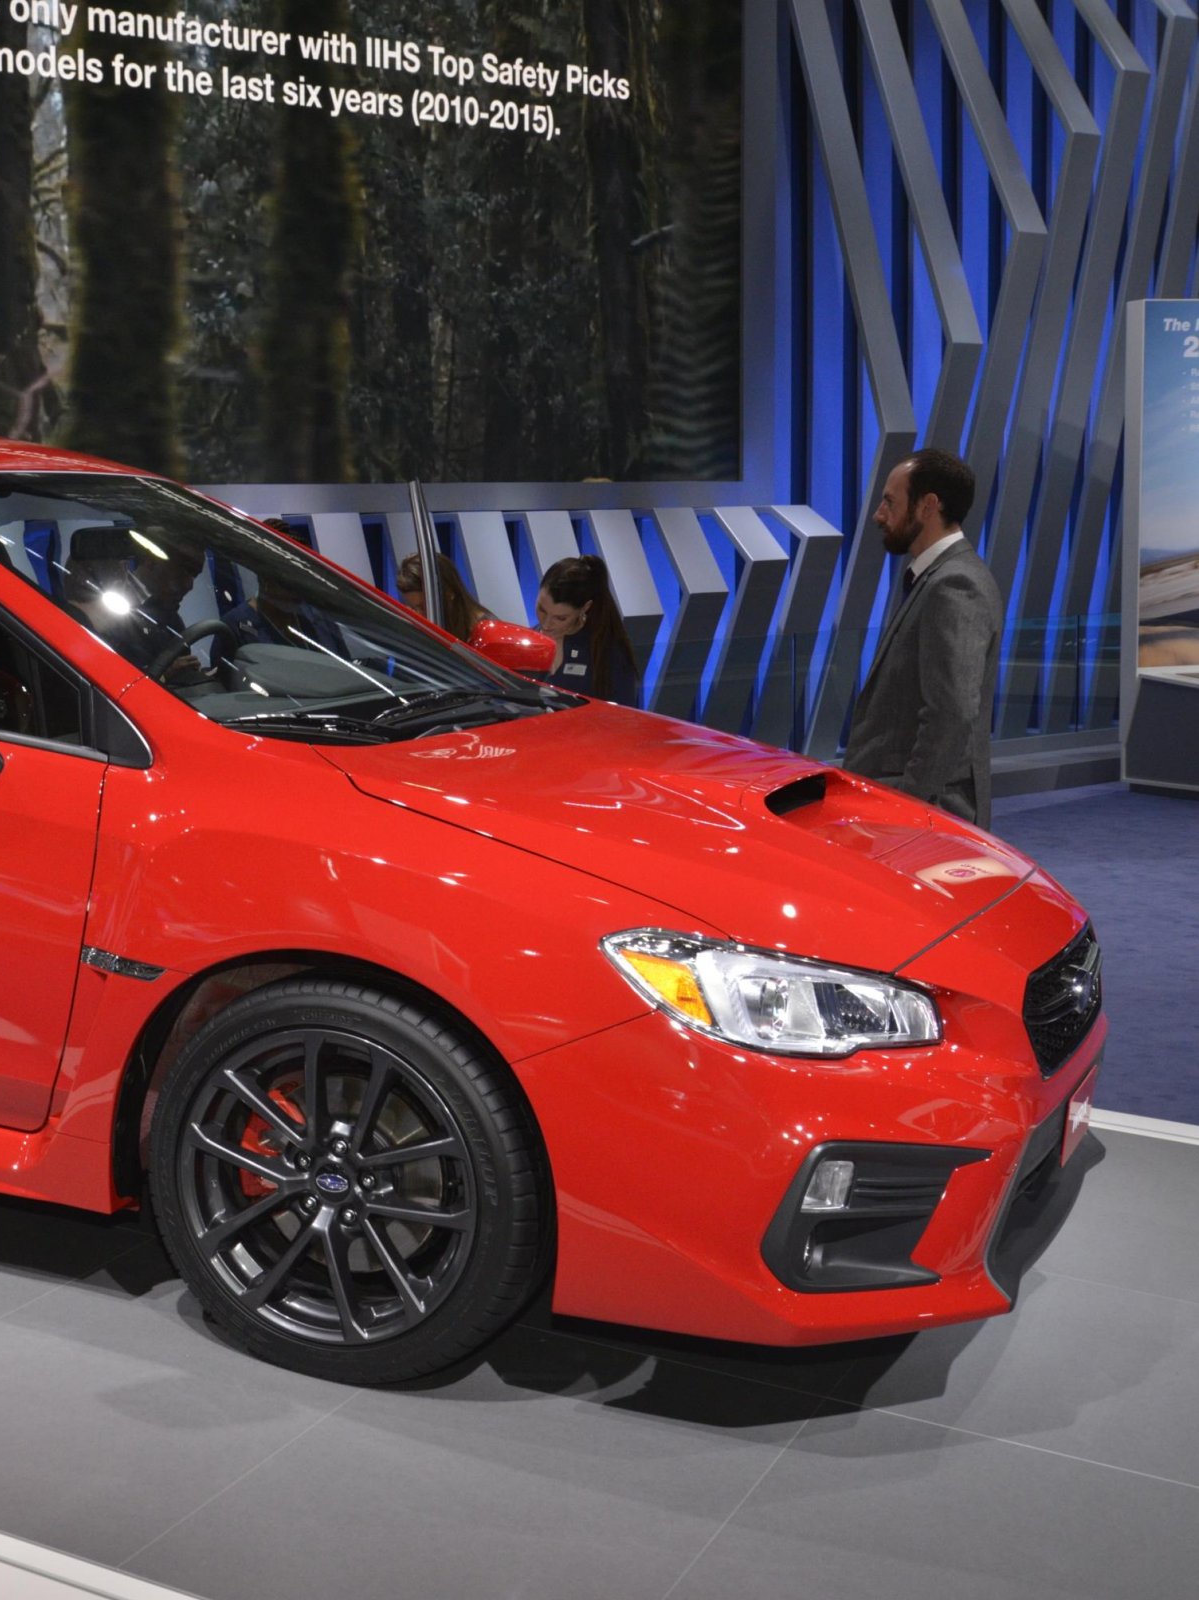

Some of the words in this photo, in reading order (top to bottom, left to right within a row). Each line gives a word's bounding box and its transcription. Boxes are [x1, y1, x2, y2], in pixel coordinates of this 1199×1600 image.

[10, 0, 77, 35] only
[87, 8, 290, 56] manufacturer
[298, 30, 356, 65] with
[366, 37, 420, 73] IIHS
[427, 46, 474, 86] Top
[482, 53, 559, 96] Safety
[566, 64, 630, 100] Picks
[112, 54, 156, 89] for
[164, 60, 212, 96] the
[223, 67, 274, 101] last
[283, 78, 322, 108] six
[329, 86, 403, 117] years
[412, 89, 561, 140] (2010-2015).
[1163, 318, 1191, 331] The
